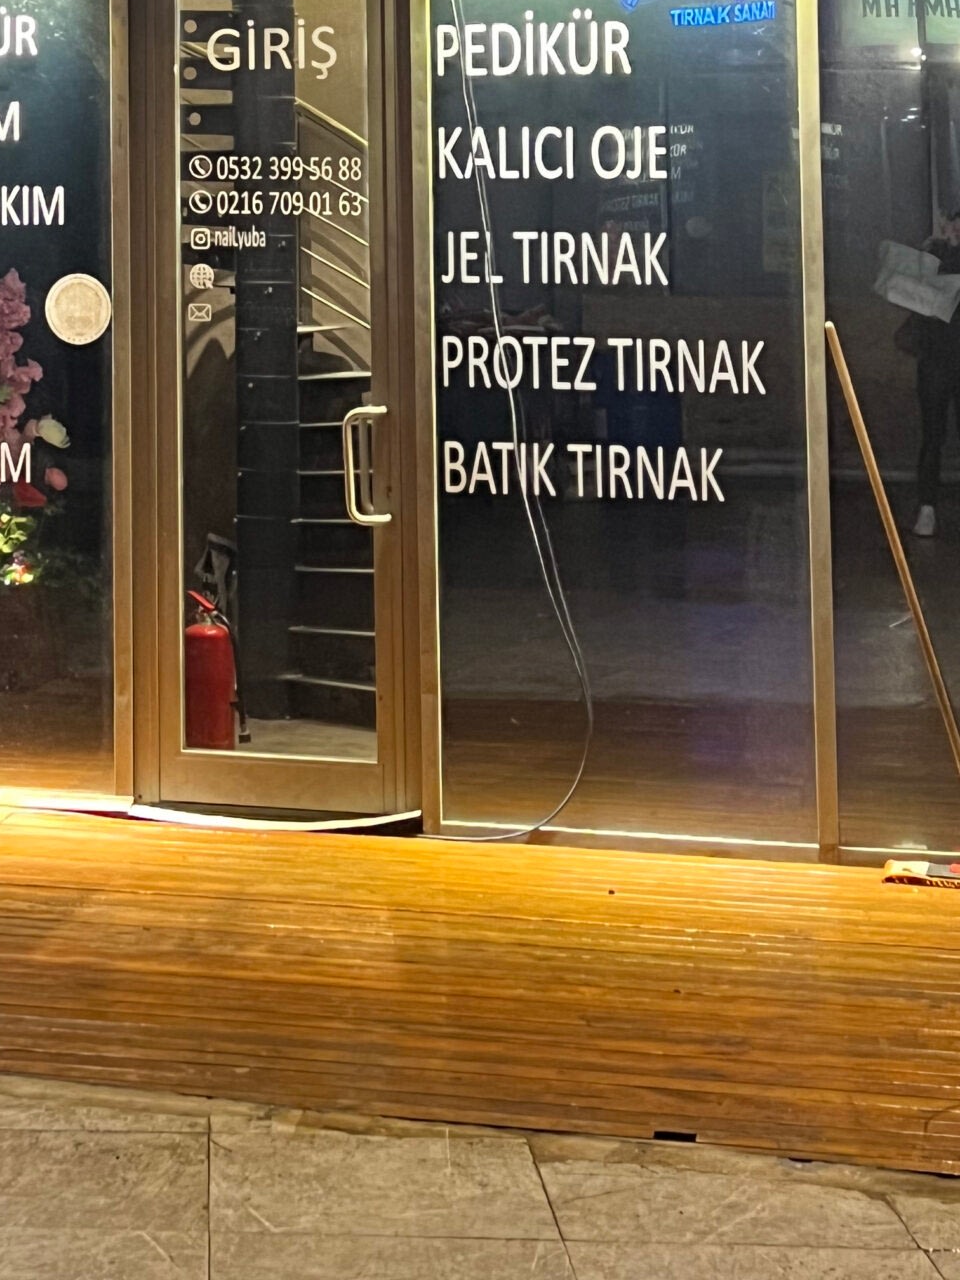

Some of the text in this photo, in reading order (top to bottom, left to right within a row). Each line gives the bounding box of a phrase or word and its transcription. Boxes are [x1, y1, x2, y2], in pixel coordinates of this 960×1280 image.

[437, 8, 632, 77] PEDİKÜR
[670, 5, 729, 26] TIRNAK
[207, 18, 337, 80] GİRİŞ
[216, 155, 362, 181] 0532 399 56 88
[438, 125, 667, 179] KALICI OJE
[216, 190, 362, 216] 0216 709 01 63
[441, 231, 669, 285] JEL TIRNAK
[442, 336, 767, 395] PROTEZ TIRNAK
[444, 441, 725, 502] BATIK TIRNAK
